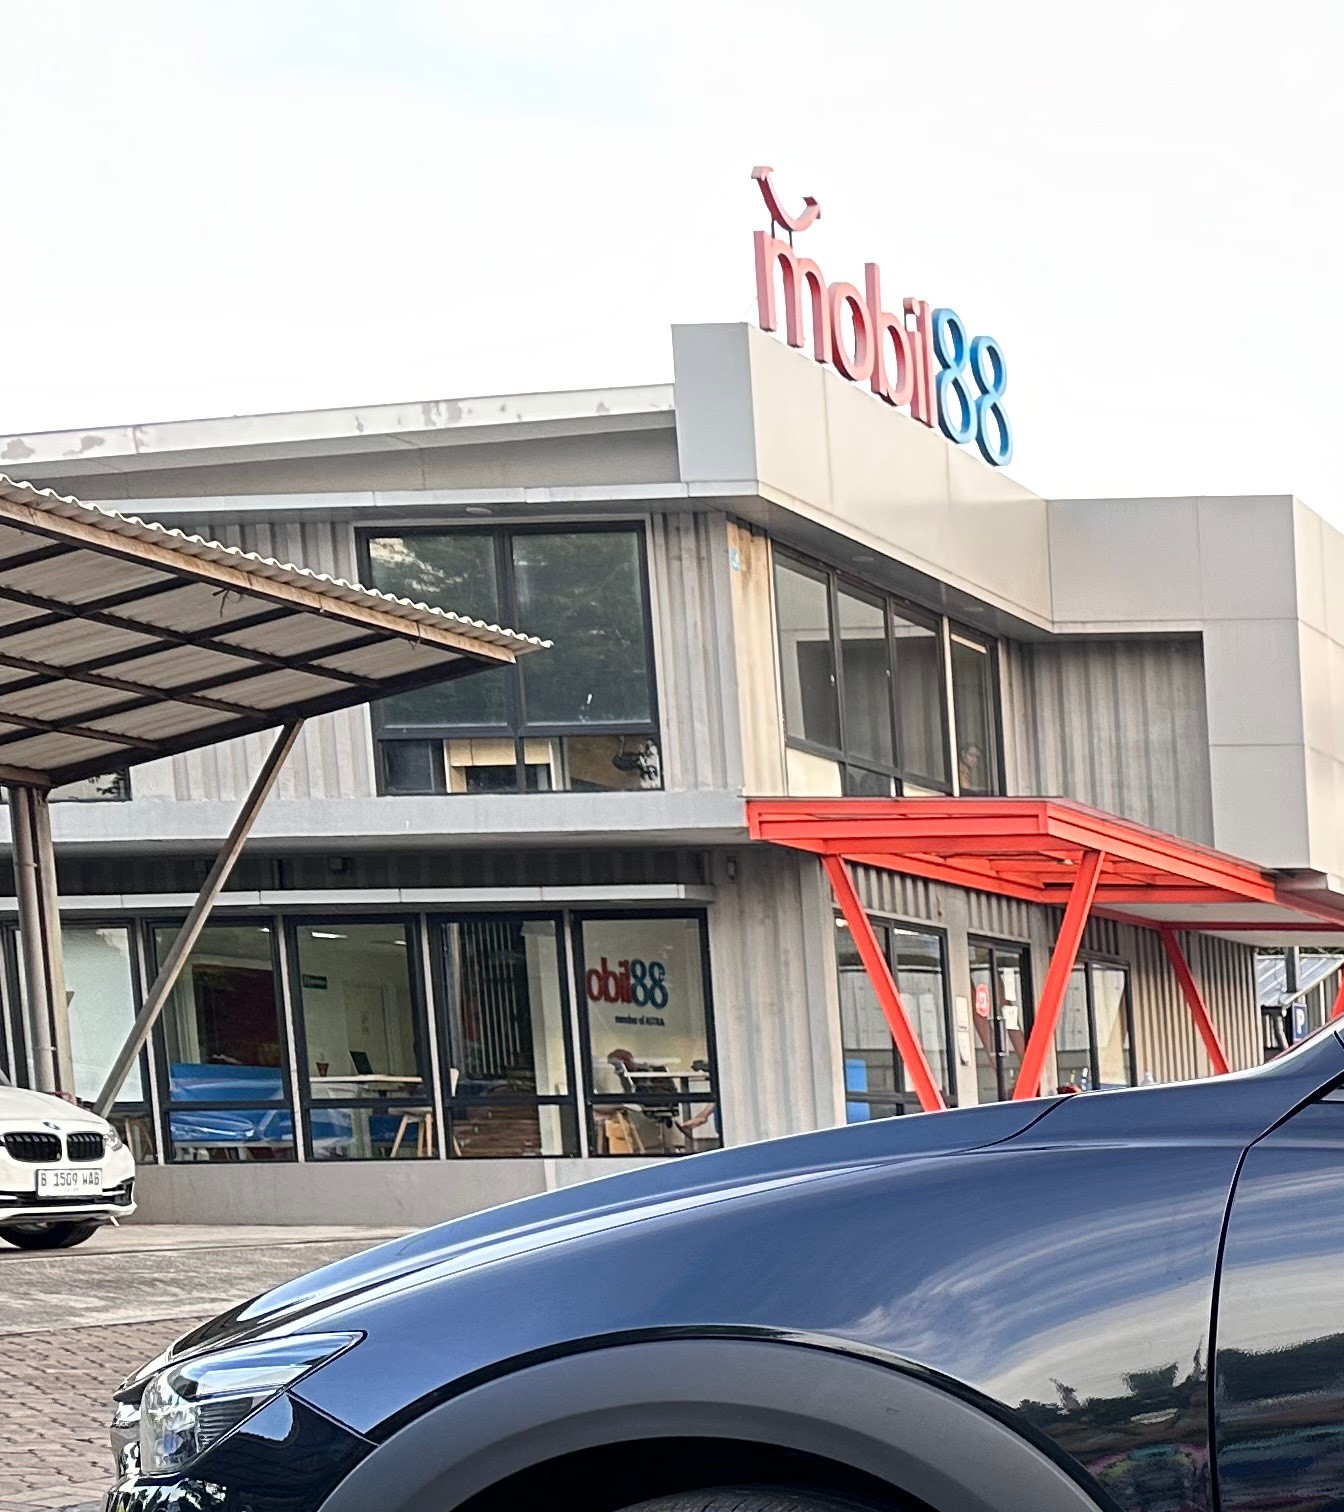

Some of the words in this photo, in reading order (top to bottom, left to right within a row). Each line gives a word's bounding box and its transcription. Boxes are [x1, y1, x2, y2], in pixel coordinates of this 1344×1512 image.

[753, 230, 1013, 466] mobil88
[586, 956, 669, 1009] obil88
[1296, 1008, 1305, 1034] P
